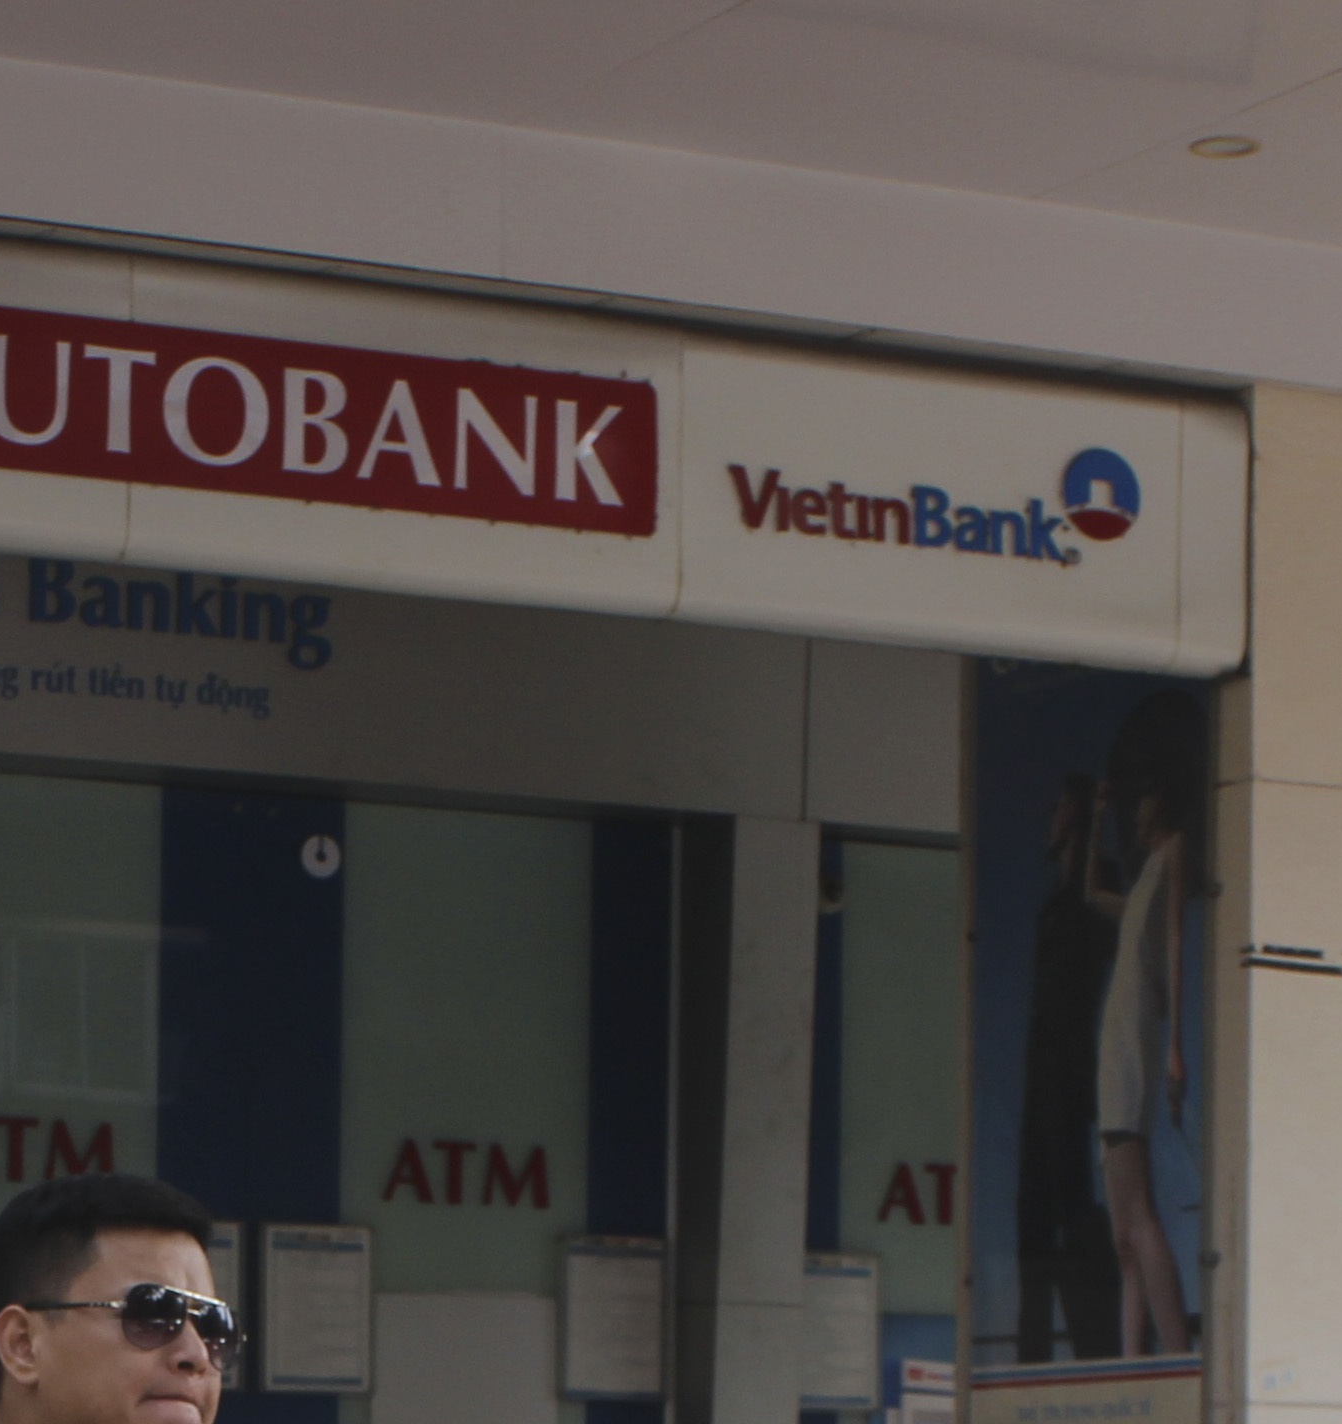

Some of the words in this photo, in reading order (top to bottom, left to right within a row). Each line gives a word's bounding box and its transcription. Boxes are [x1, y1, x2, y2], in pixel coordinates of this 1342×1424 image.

[727, 463, 1069, 564] VietinBank
[29, 557, 332, 671] Banking
[31, 660, 76, 695] rút
[197, 670, 271, 718] động
[382, 1138, 550, 1210] ATM
[877, 1163, 956, 1226] AT
